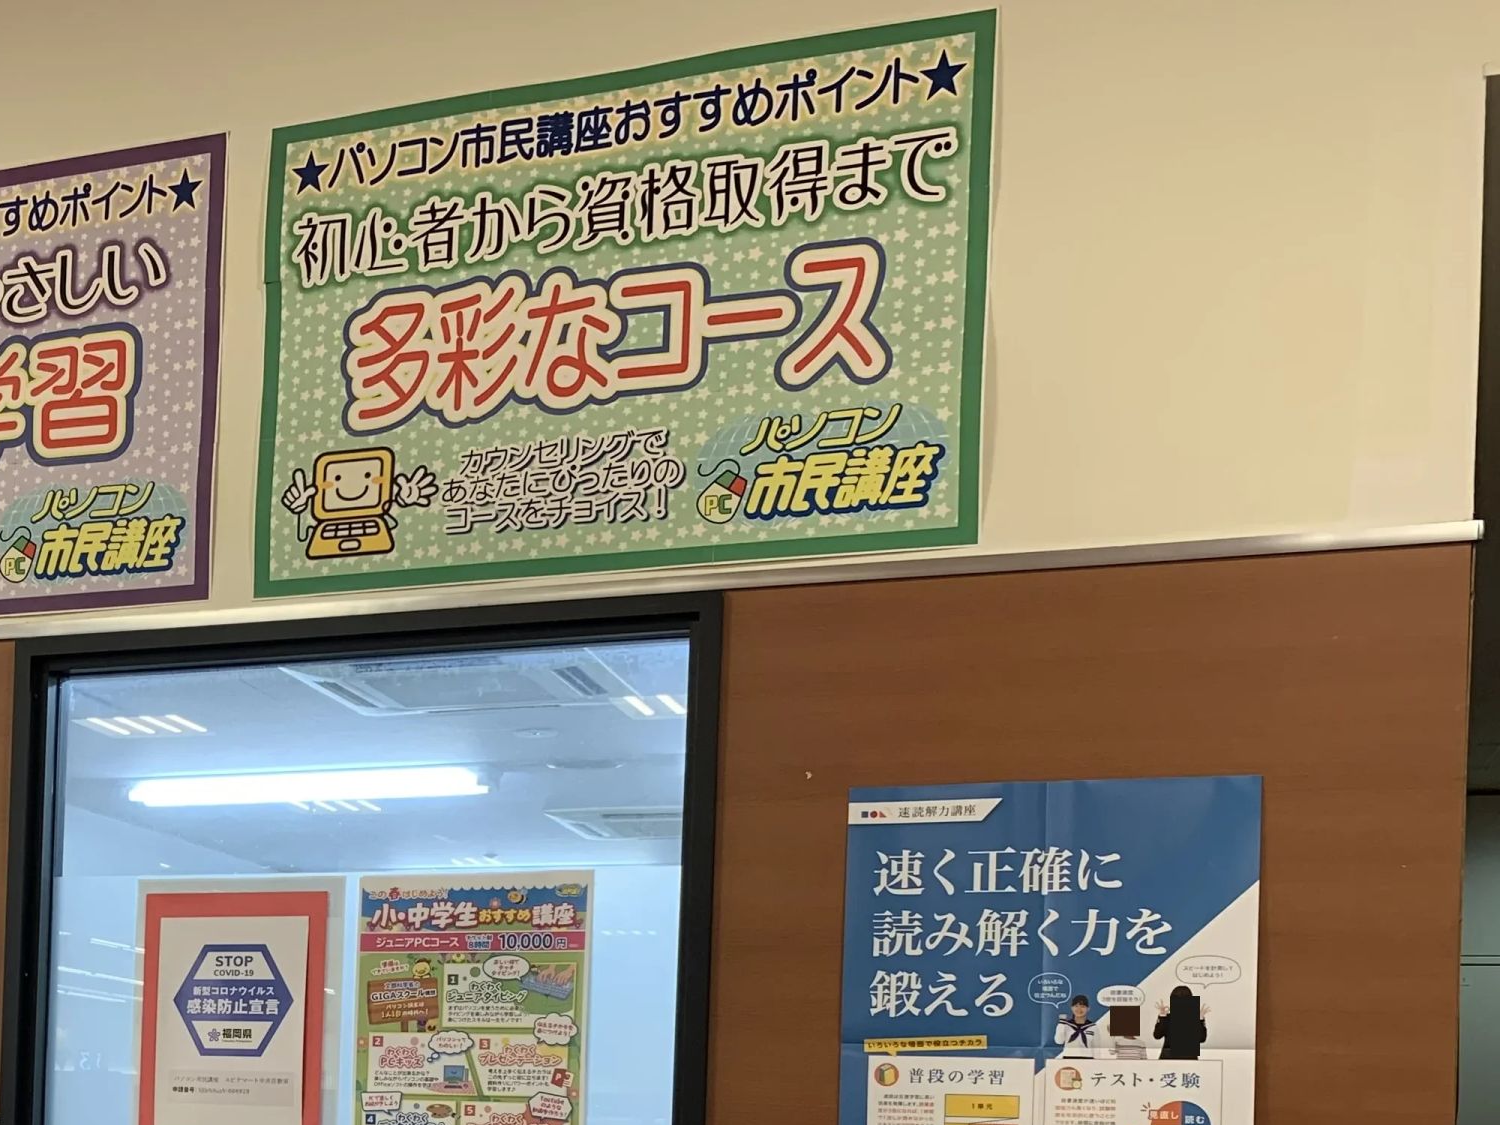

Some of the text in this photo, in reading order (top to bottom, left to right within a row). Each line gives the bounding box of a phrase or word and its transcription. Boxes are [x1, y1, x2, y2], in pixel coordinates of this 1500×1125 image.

[327, 56, 919, 188] パソコン市民講座おすすめポイント
[296, 129, 958, 283] 初心者から資格取得まで
[351, 247, 883, 428] 多彩なコース
[740, 403, 903, 458] パソコン
[459, 430, 668, 477] カウンセリングで
[745, 445, 946, 518] 市民講座
[31, 481, 155, 524] パソコン
[33, 516, 184, 582] 市民講座
[898, 803, 977, 819] 速読解力講座
[872, 846, 1123, 897] 速く正確に
[871, 907, 1173, 958] 読み解く力を
[376, 937, 459, 948] ジュニアPCコース
[215, 956, 254, 967] STOP
[213, 969, 254, 977] COVID-19
[193, 986, 274, 995] 新型コロナウイルス
[470, 982, 501, 992] わくわく
[869, 969, 1015, 1019] 鍛える
[446, 991, 527, 1002] ジュニアタイピング
[187, 999, 280, 1015] 感染防止宣言
[222, 1029, 252, 1039] 福岡県
[385, 1046, 418, 1057] わくわく
[379, 1056, 424, 1068] PCキッズ
[907, 1068, 1006, 1086] 普段の学習
[1089, 1071, 1202, 1090] テスト・受験
[1149, 1108, 1179, 1121] 見直し
[1184, 1113, 1205, 1125] 読む
